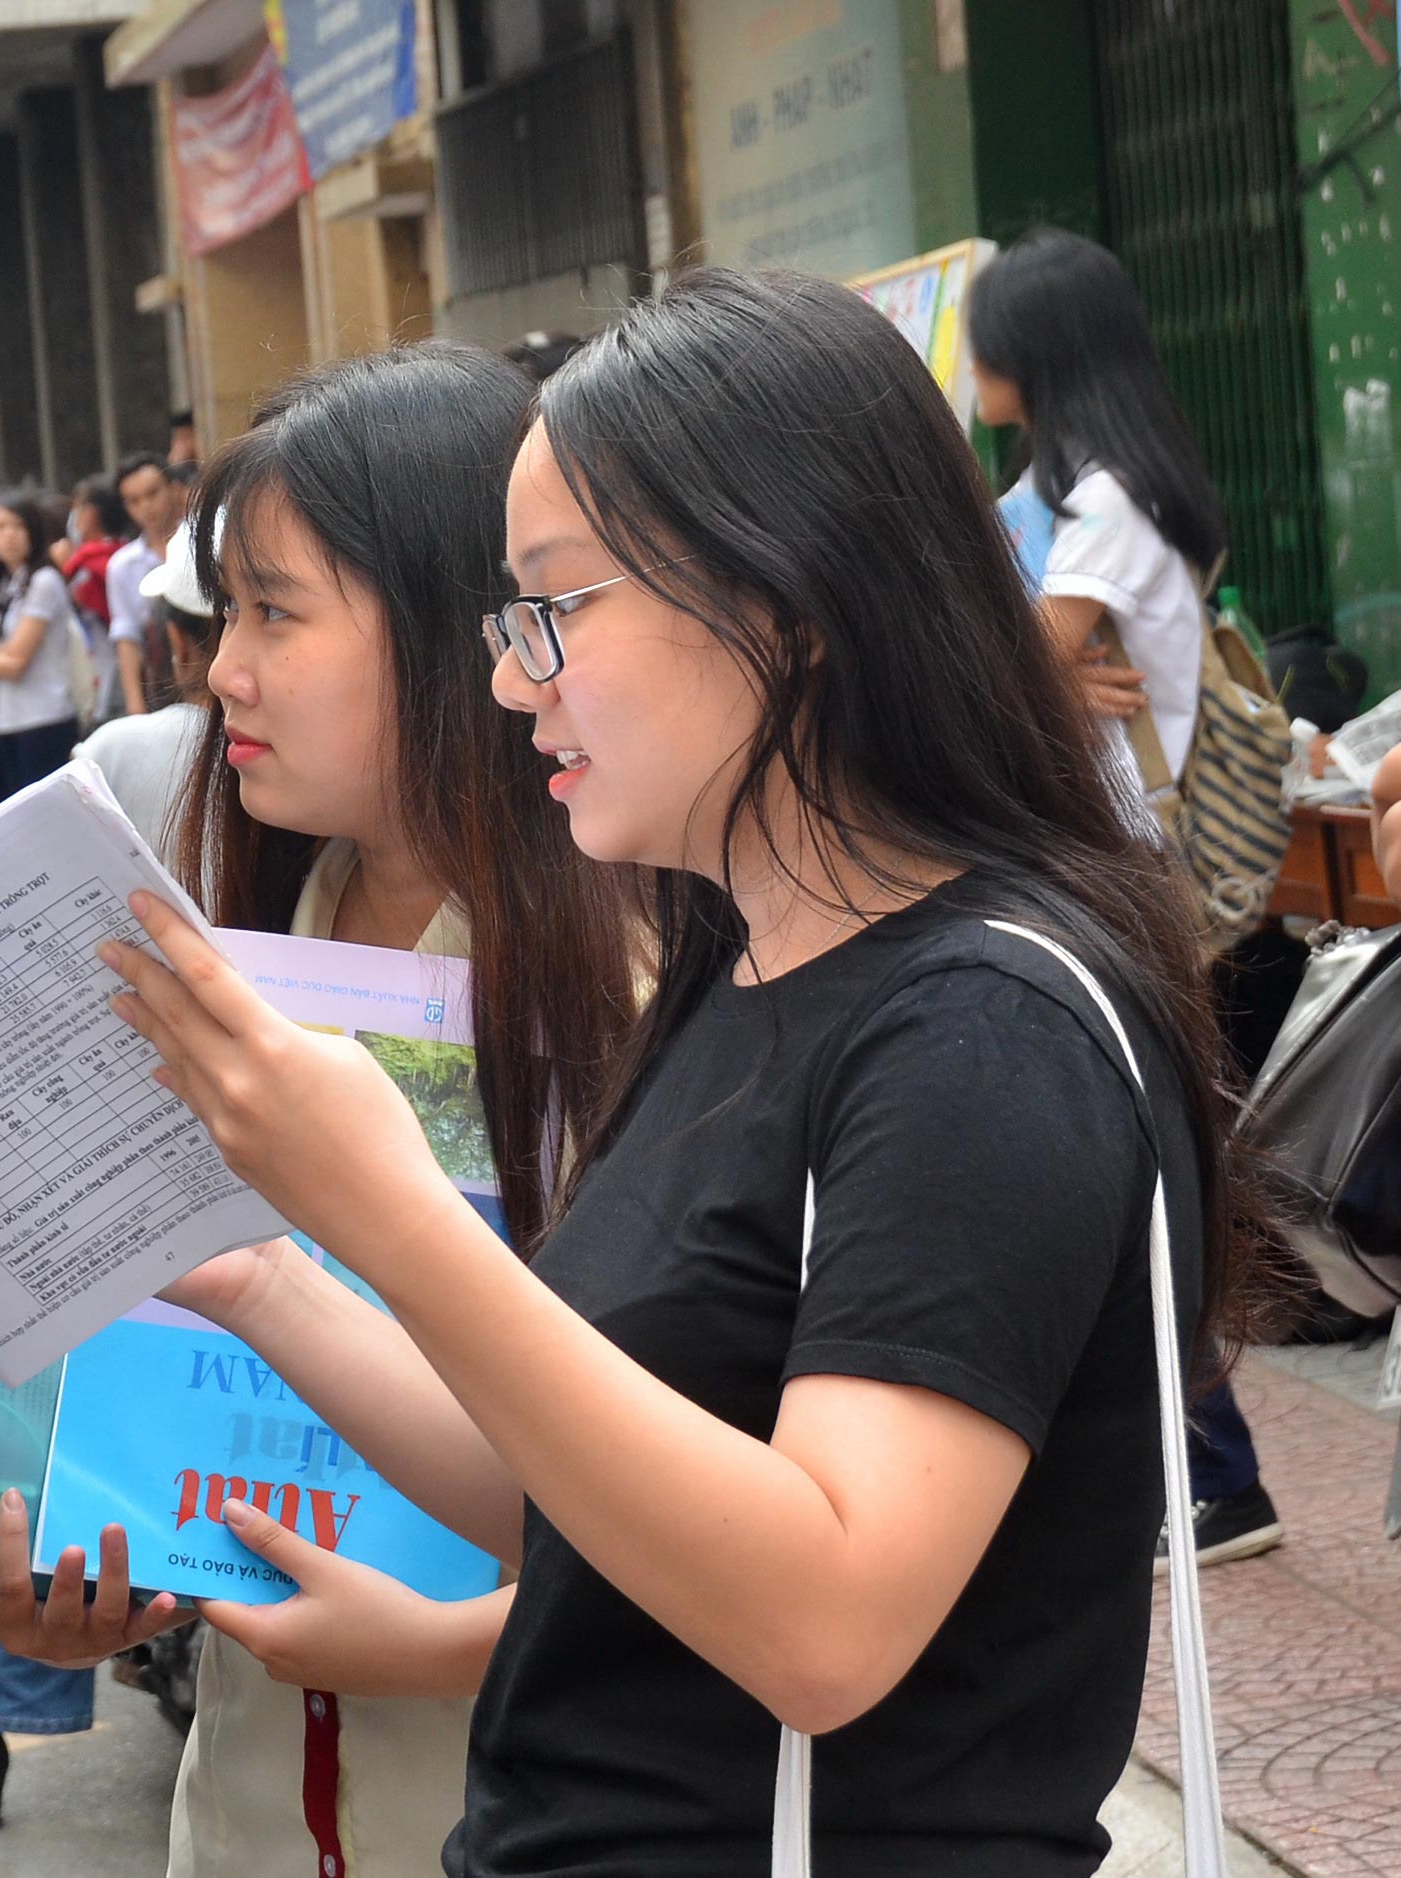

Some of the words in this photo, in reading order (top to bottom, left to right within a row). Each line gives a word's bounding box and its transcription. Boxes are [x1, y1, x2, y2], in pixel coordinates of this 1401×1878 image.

[254, 975, 276, 986] NAM
[126, 1029, 140, 1040] kh
[101, 1068, 116, 1081] 100
[58, 1097, 73, 1110] 100
[17, 1127, 32, 1139] 100
[163, 1250, 176, 1262] 47
[168, 1553, 198, 1569] TẠO
[202, 1559, 234, 1577] ĐÀO
[239, 1564, 258, 1580] VÀ
